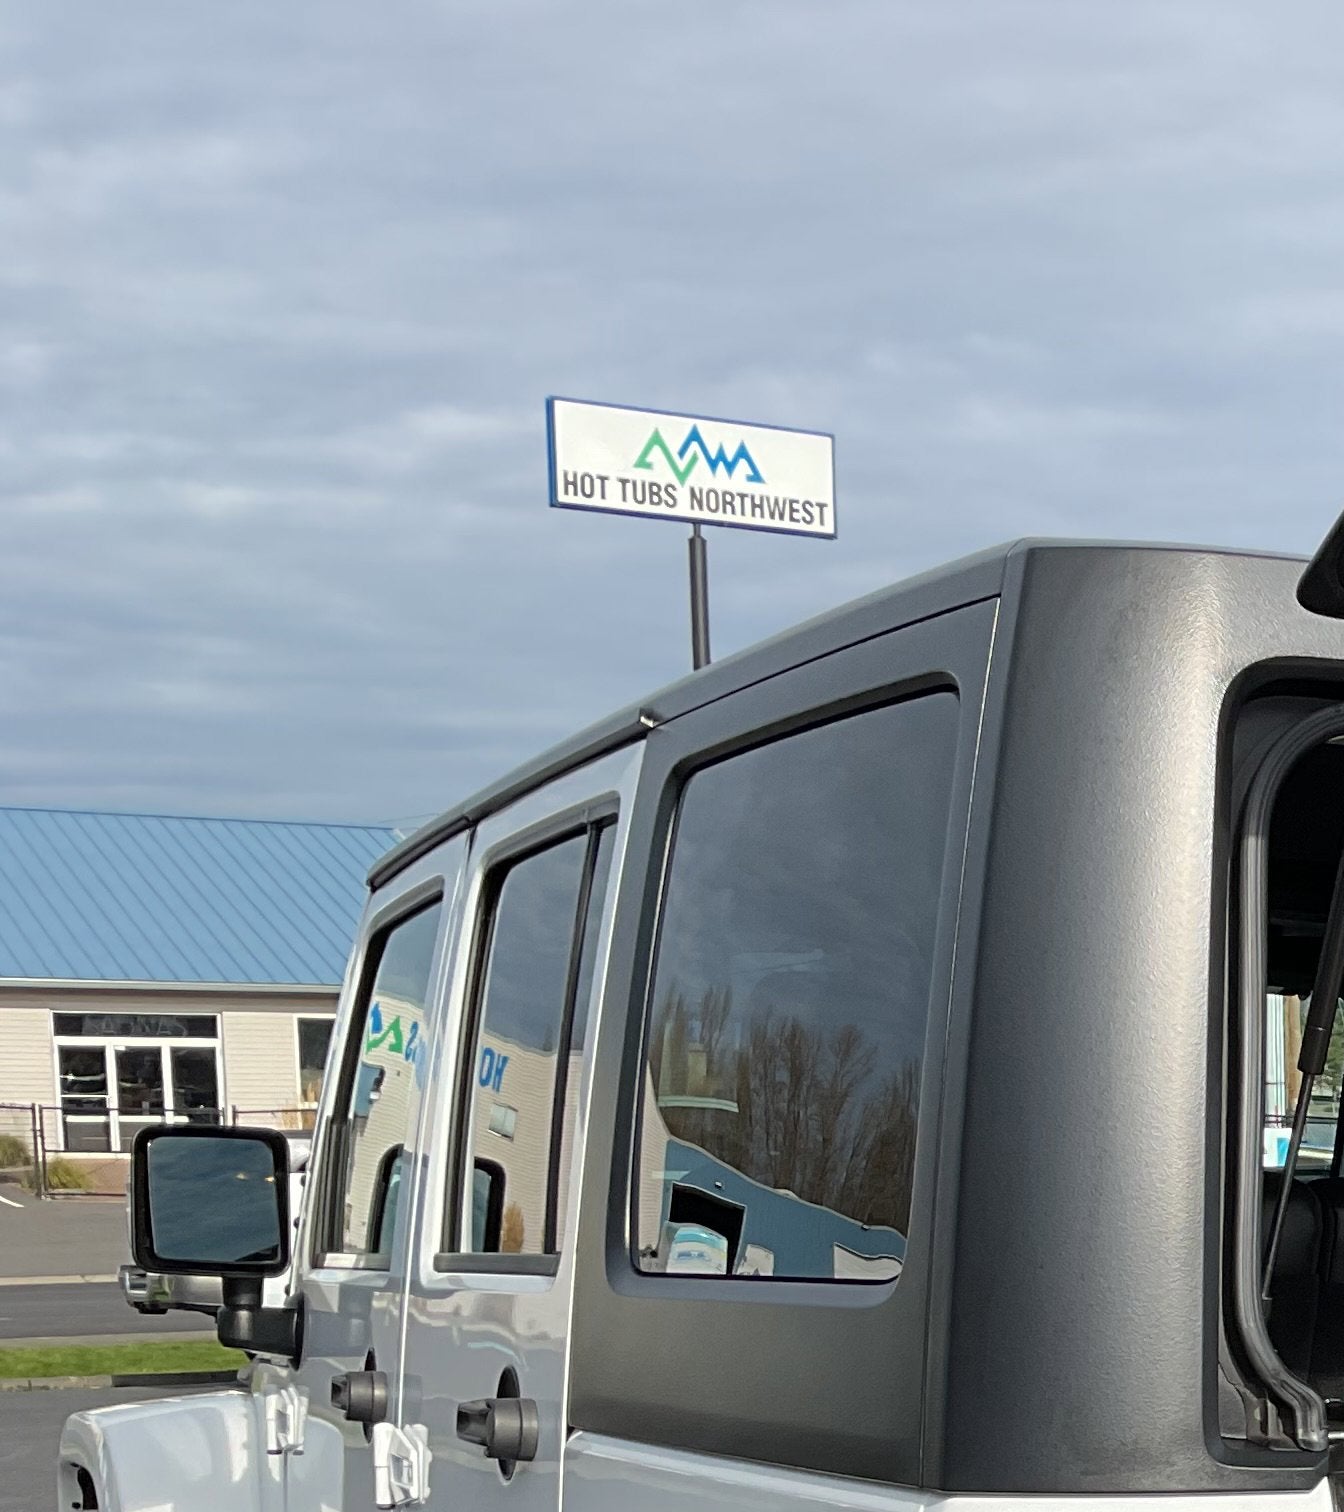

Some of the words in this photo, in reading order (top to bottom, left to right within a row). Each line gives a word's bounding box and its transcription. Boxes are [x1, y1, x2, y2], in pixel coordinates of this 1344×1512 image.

[563, 469, 609, 500] HOT
[616, 477, 678, 509] TUBS
[689, 486, 829, 527] NORTHWEST
